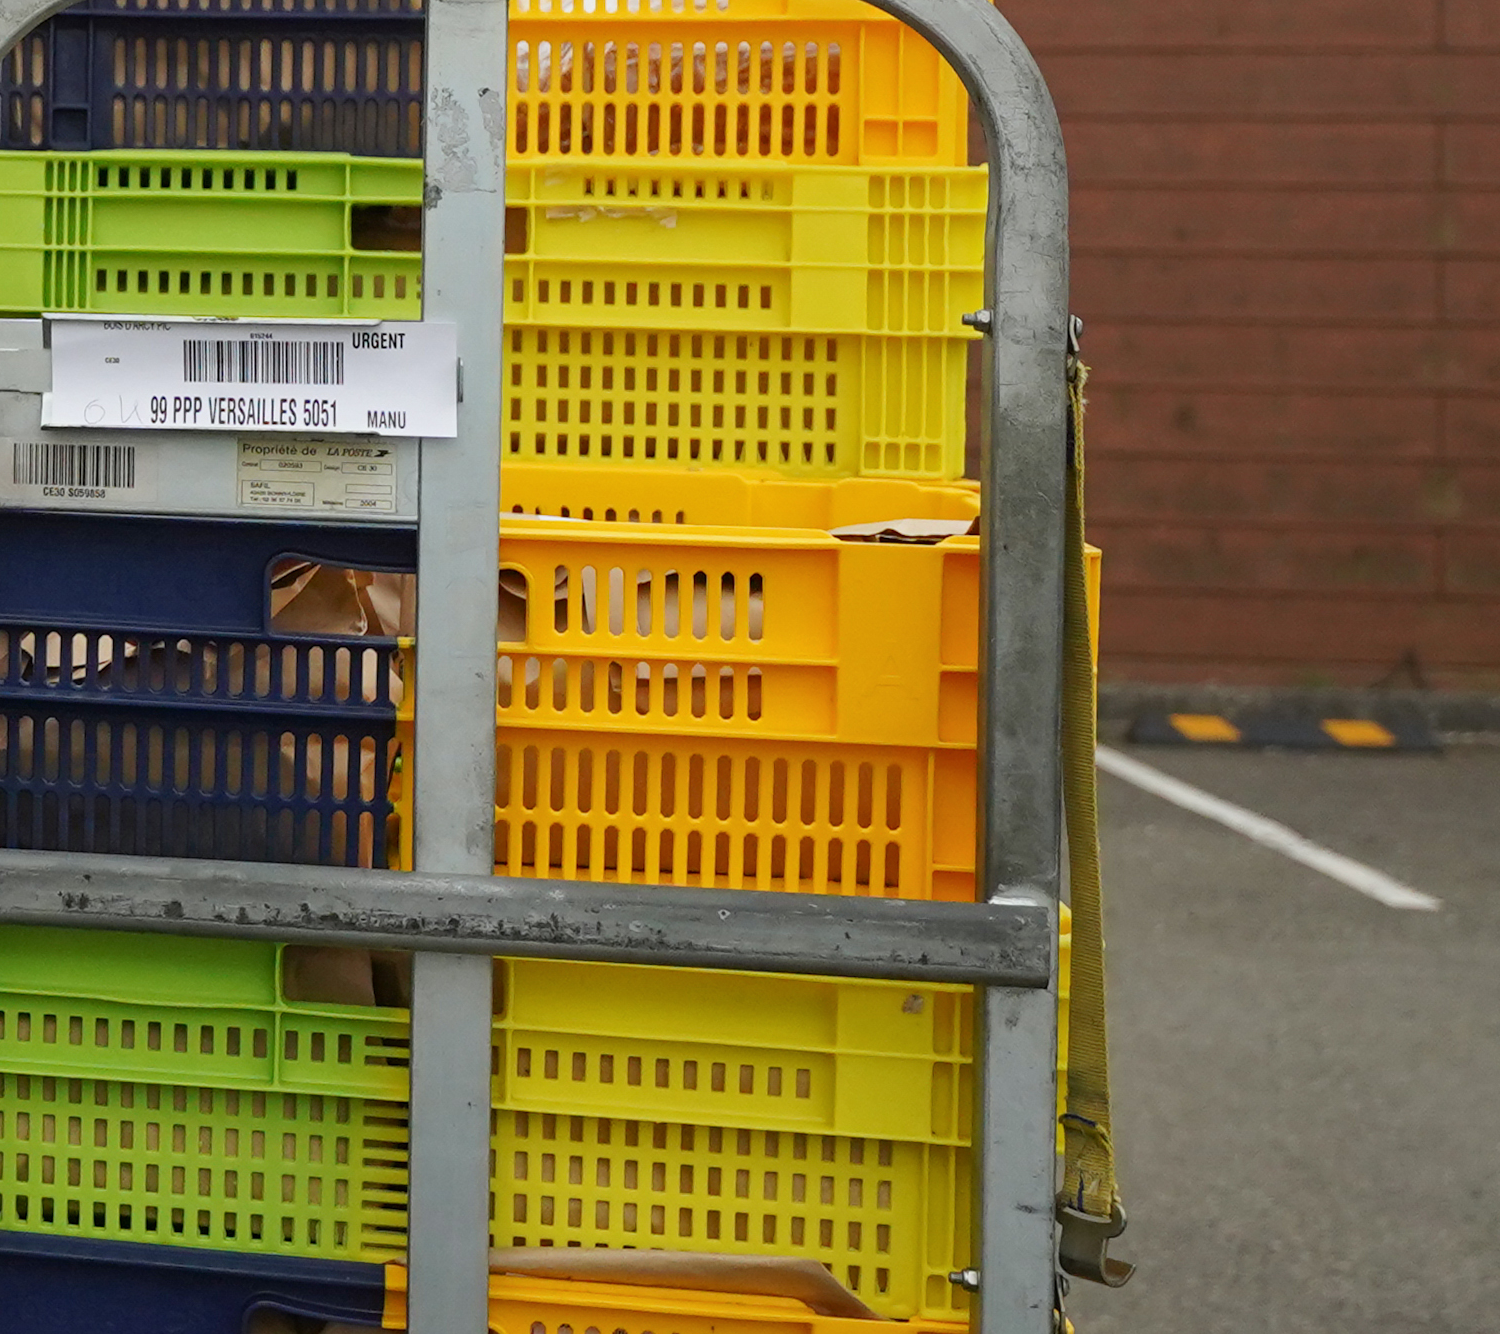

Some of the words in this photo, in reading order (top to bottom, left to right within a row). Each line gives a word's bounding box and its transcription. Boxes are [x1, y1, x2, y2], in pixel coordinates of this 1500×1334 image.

[351, 331, 406, 350] URGENT
[150, 395, 168, 424] 99
[173, 396, 202, 424] PPP
[208, 397, 297, 426] VERSAILLES
[303, 398, 337, 427] 5051
[367, 410, 407, 429] MANU
[242, 443, 297, 456] Propriété
[301, 444, 317, 455] de
[326, 447, 340, 457] LA
[341, 447, 374, 458] POSTE
[42, 486, 66, 497] CE30
